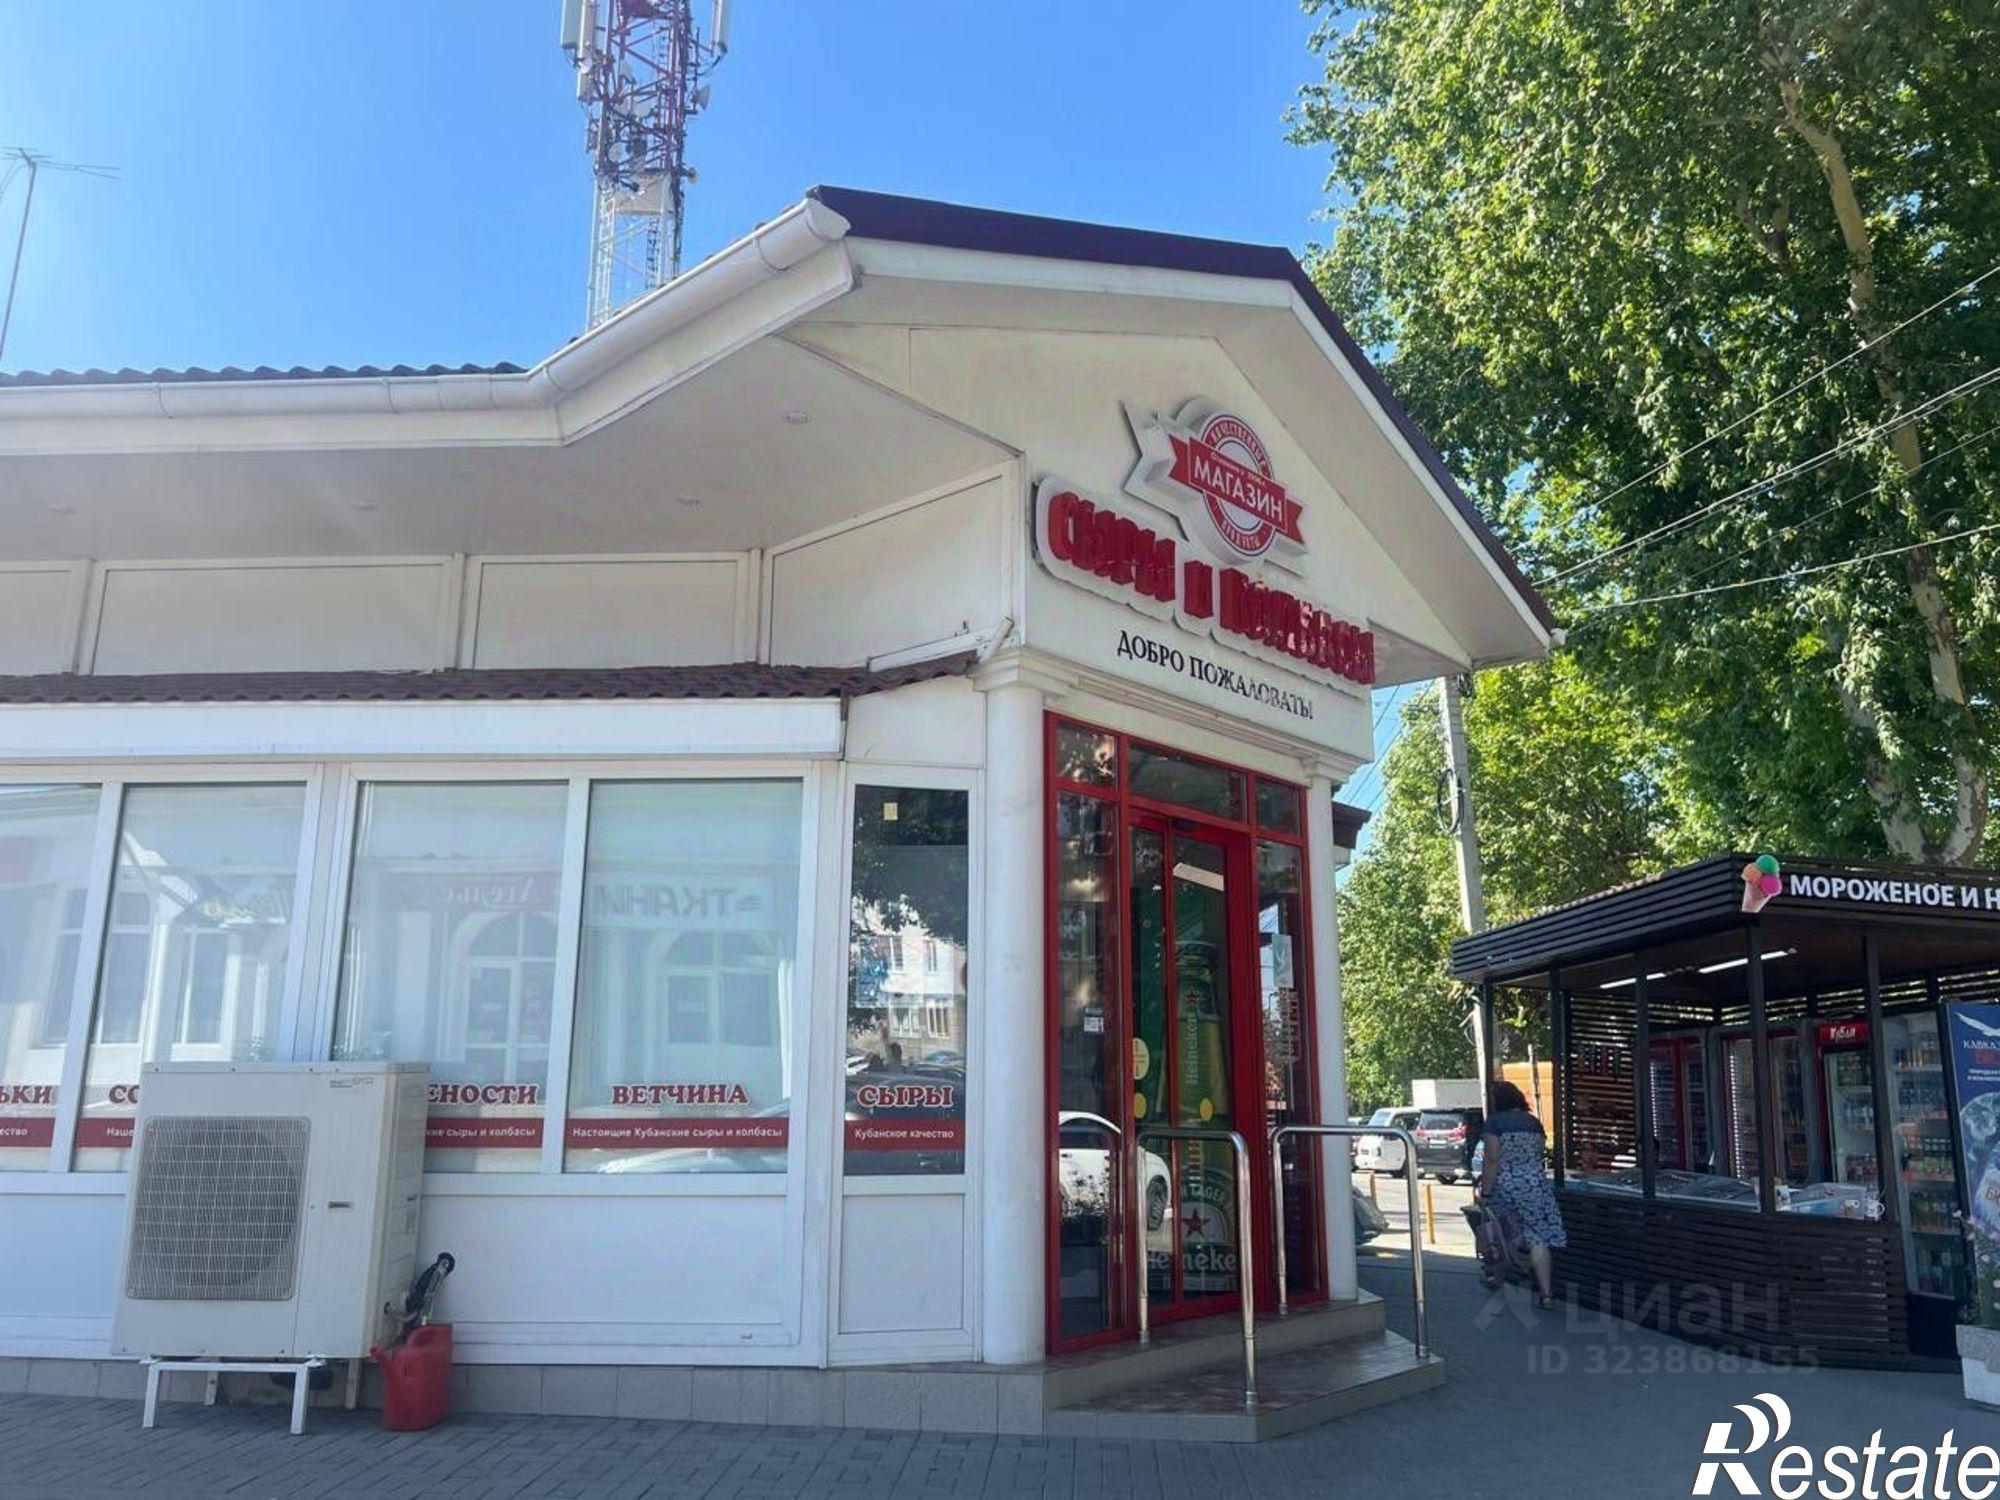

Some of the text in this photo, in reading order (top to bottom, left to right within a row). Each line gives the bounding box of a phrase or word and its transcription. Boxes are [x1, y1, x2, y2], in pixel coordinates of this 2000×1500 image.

[1194, 454, 1283, 523] МАГАЗИН
[1117, 630, 1185, 673] ДОБРО
[1790, 874, 1956, 908] МОРОЖЕНОЕ
[1960, 886, 1979, 909] И
[612, 1083, 749, 1105] ВЕТЧИНА
[858, 1085, 954, 1107] СЫРЫ
[446, 1128, 478, 1138] сыры
[489, 1126, 536, 1137] колбасы
[572, 1126, 783, 1139] Настоящие Кубанские сыры и колбасы
[854, 1128, 954, 1140] Кубанское качество
